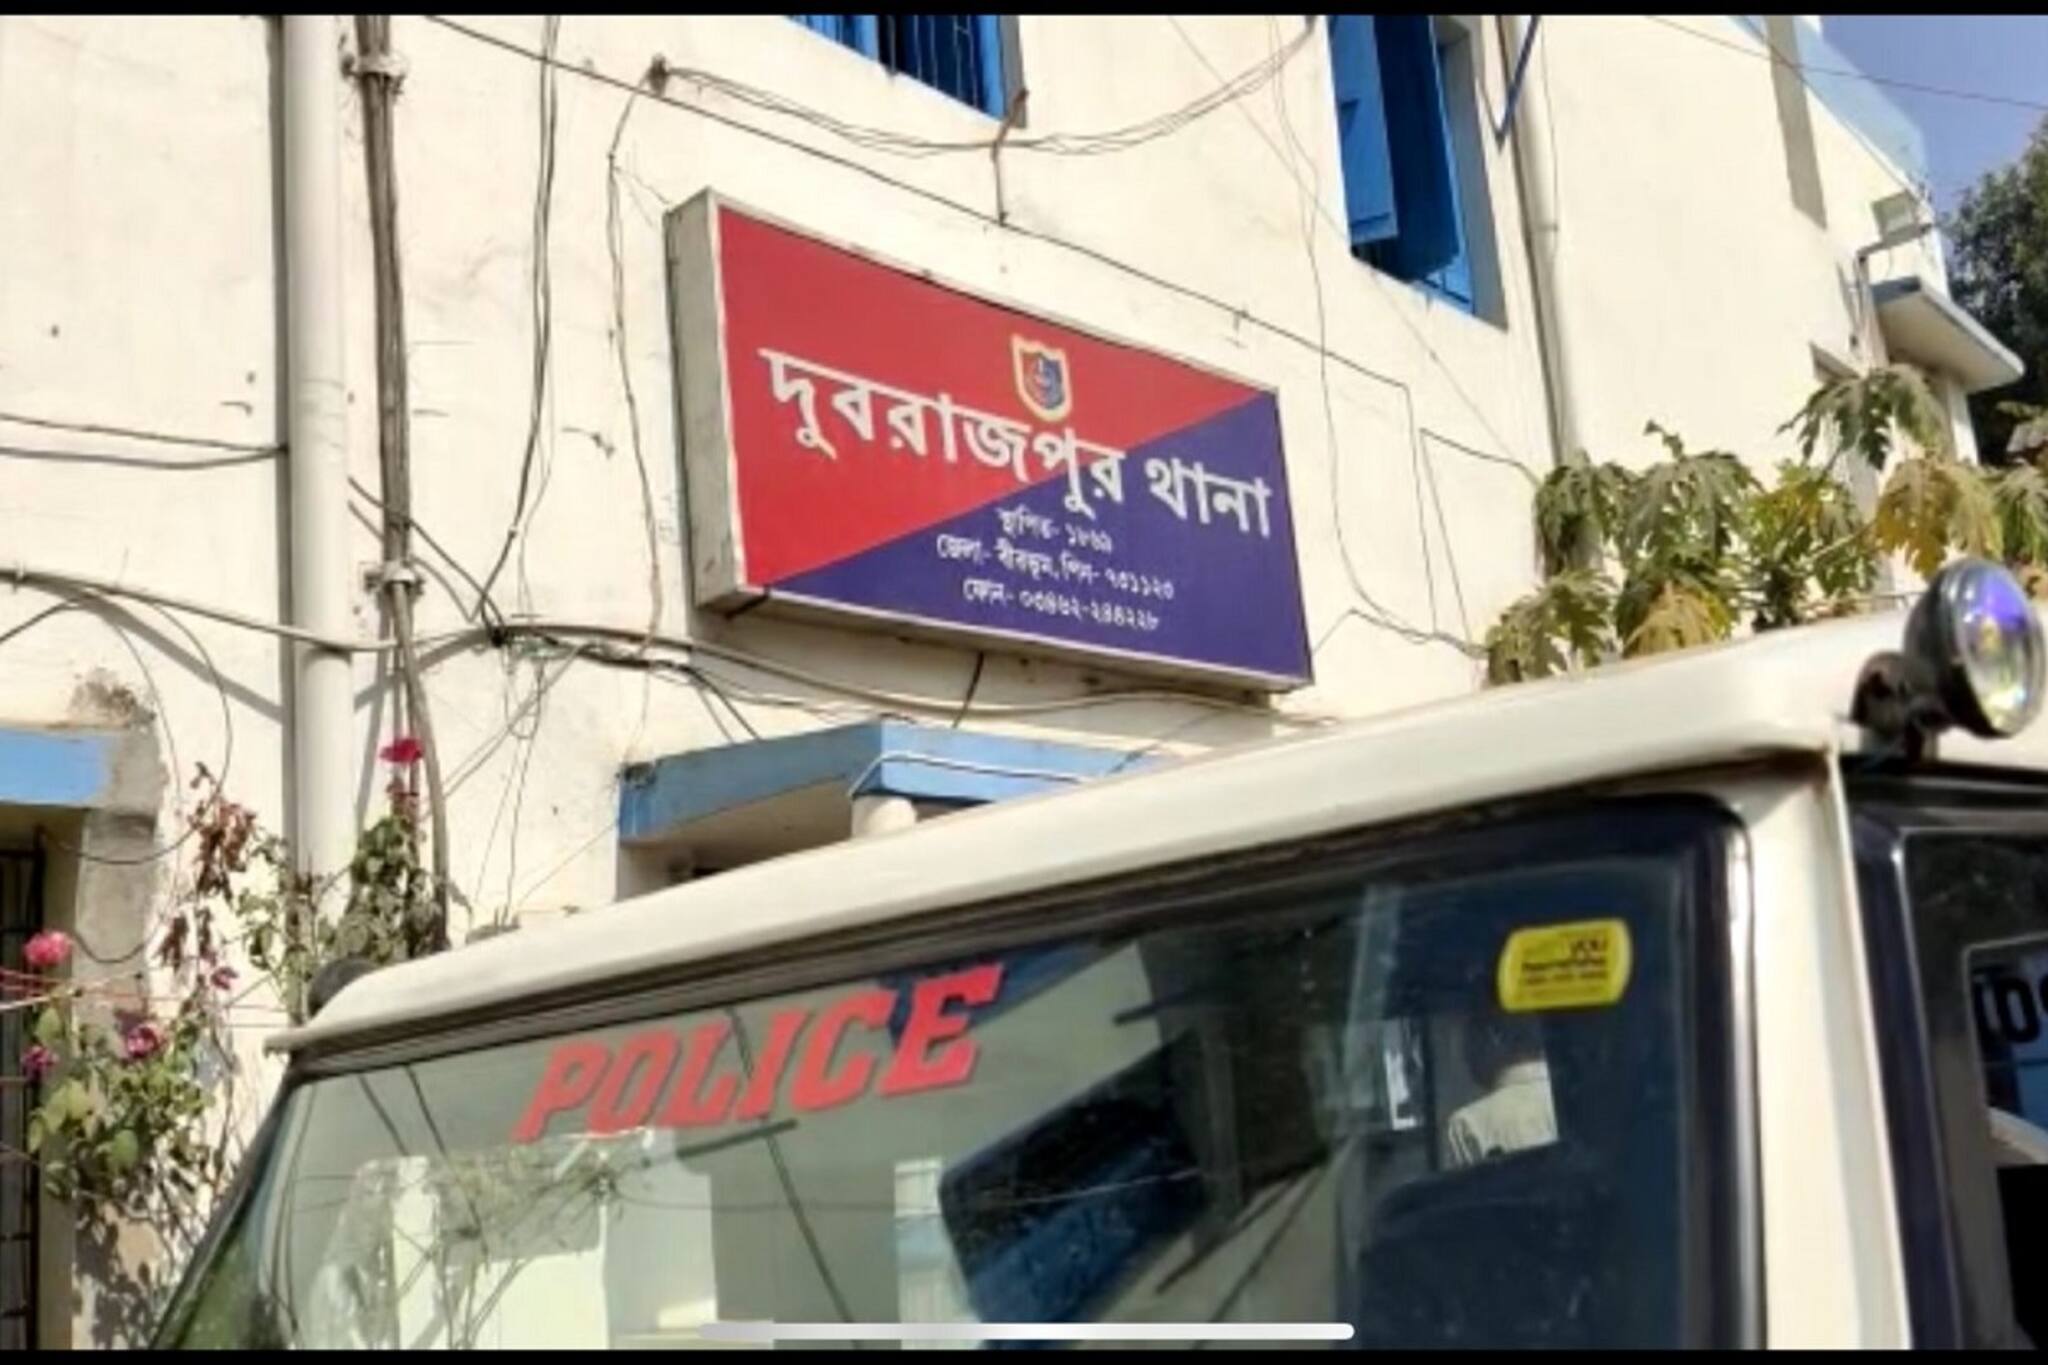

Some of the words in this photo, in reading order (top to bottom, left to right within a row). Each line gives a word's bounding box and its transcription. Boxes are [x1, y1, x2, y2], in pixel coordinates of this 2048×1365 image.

[757, 347, 1131, 518] দুবরাজপুর
[1145, 455, 1272, 538] থানা
[512, 962, 1003, 1144] POLICE
